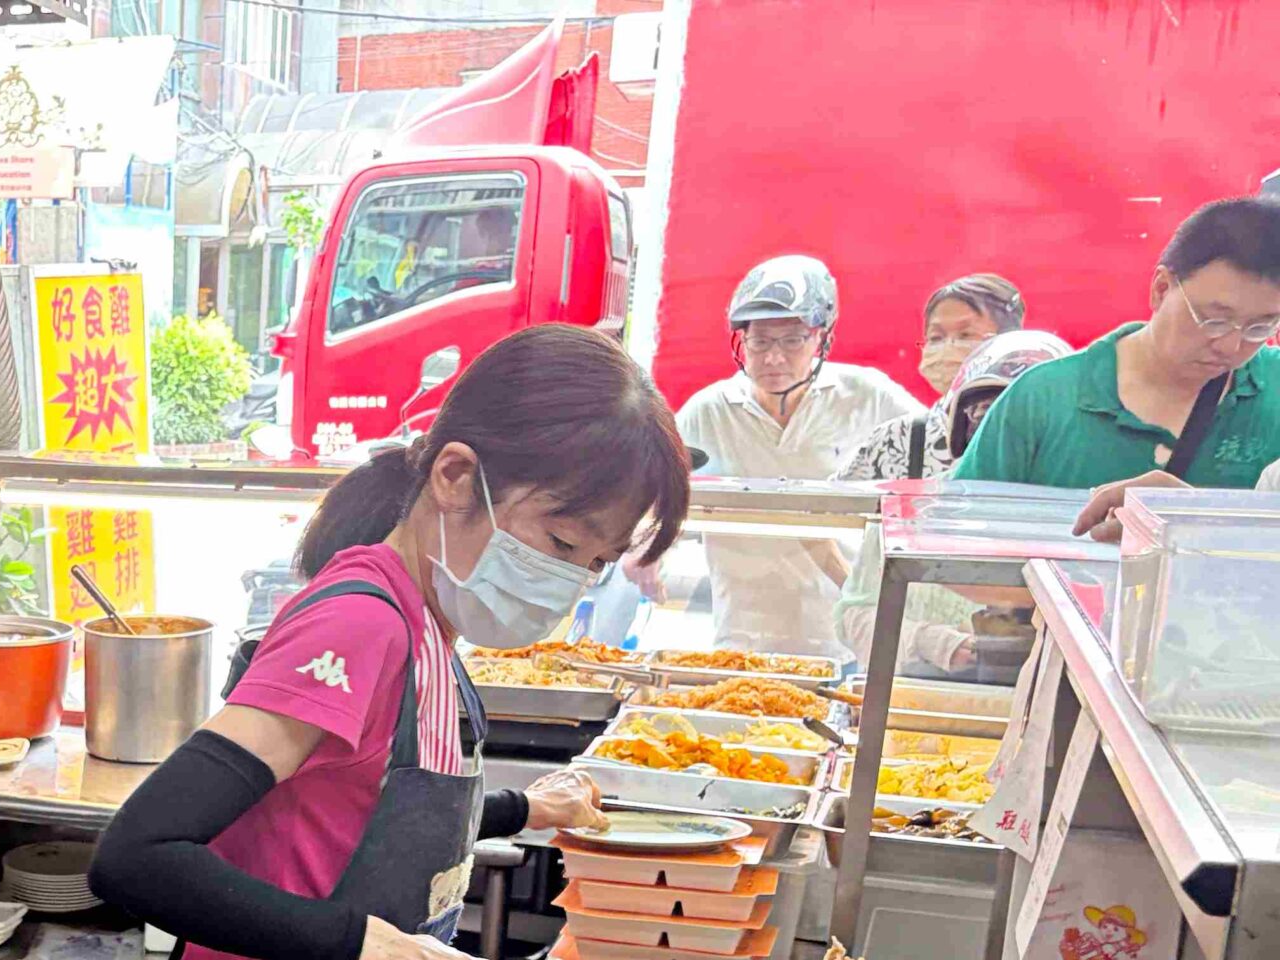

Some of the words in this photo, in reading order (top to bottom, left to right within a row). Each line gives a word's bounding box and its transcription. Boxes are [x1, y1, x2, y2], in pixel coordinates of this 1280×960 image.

[51, 285, 131, 342] 好食雞
[74, 363, 126, 415] 超大
